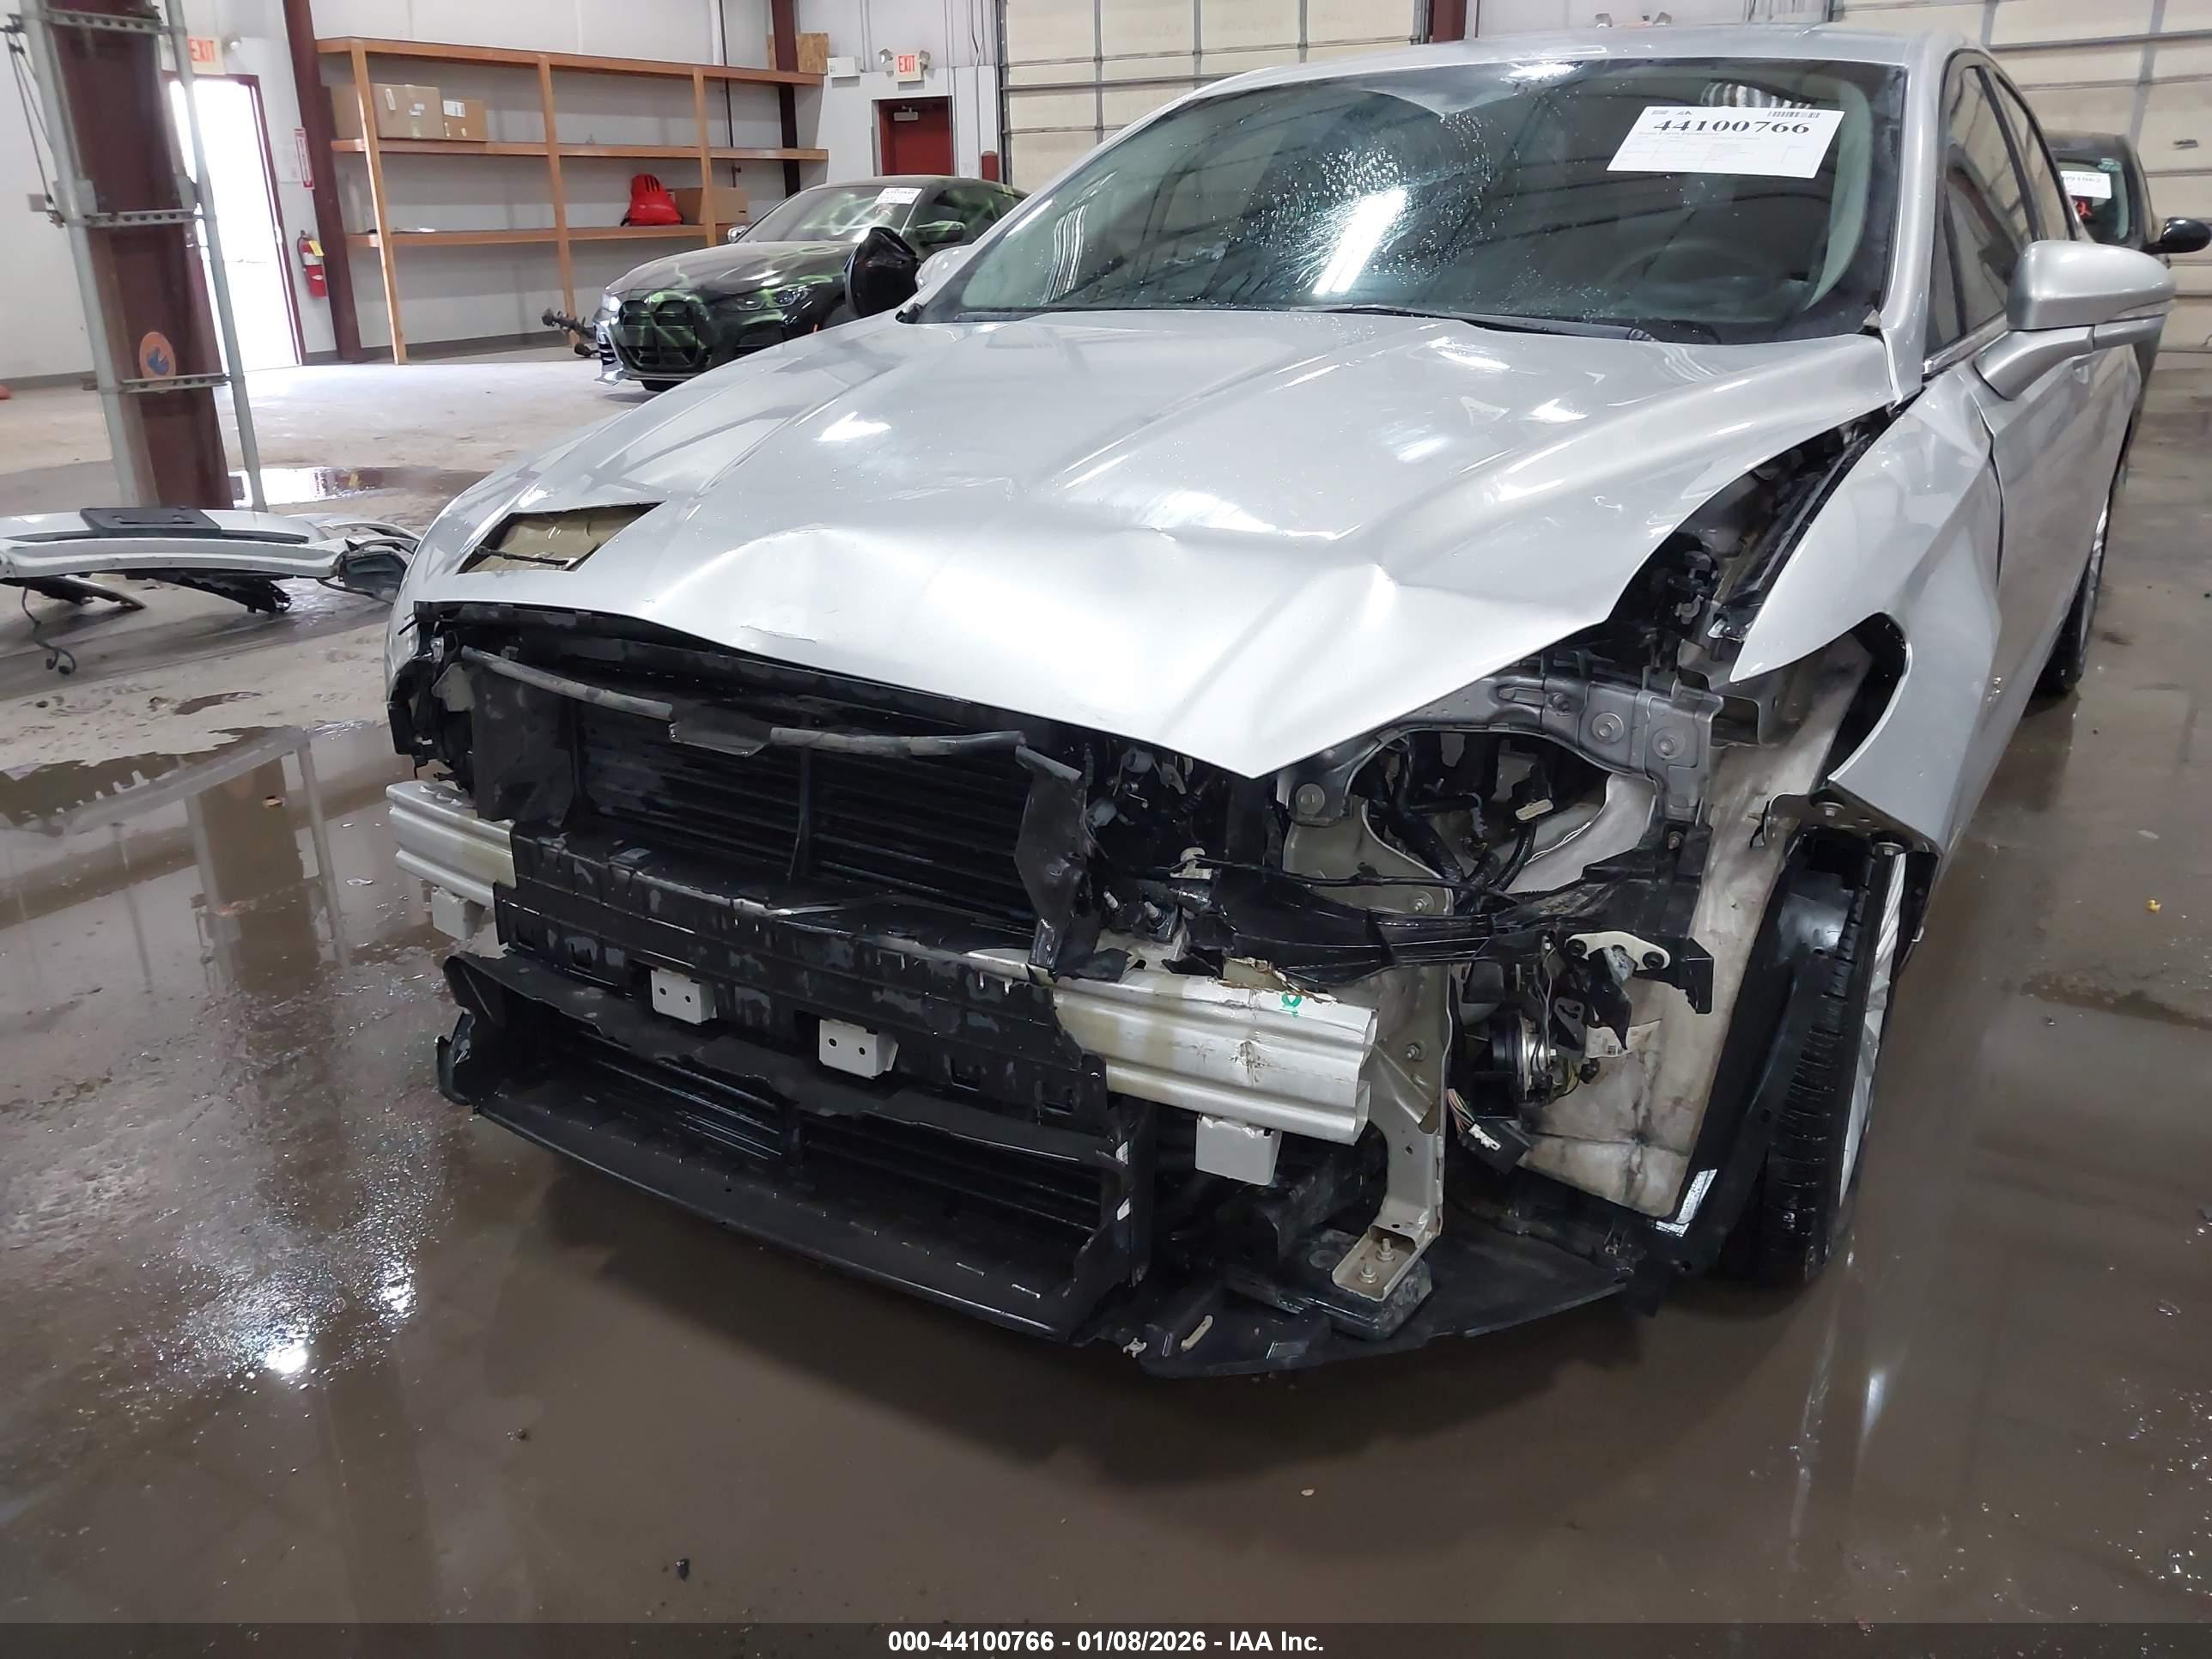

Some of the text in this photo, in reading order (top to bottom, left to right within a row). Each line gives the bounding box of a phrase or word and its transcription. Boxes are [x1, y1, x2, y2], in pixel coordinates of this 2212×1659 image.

[188, 38, 216, 62] EXIT
[898, 55, 915, 73] EXIT
[1653, 119, 1812, 134] 44100766
